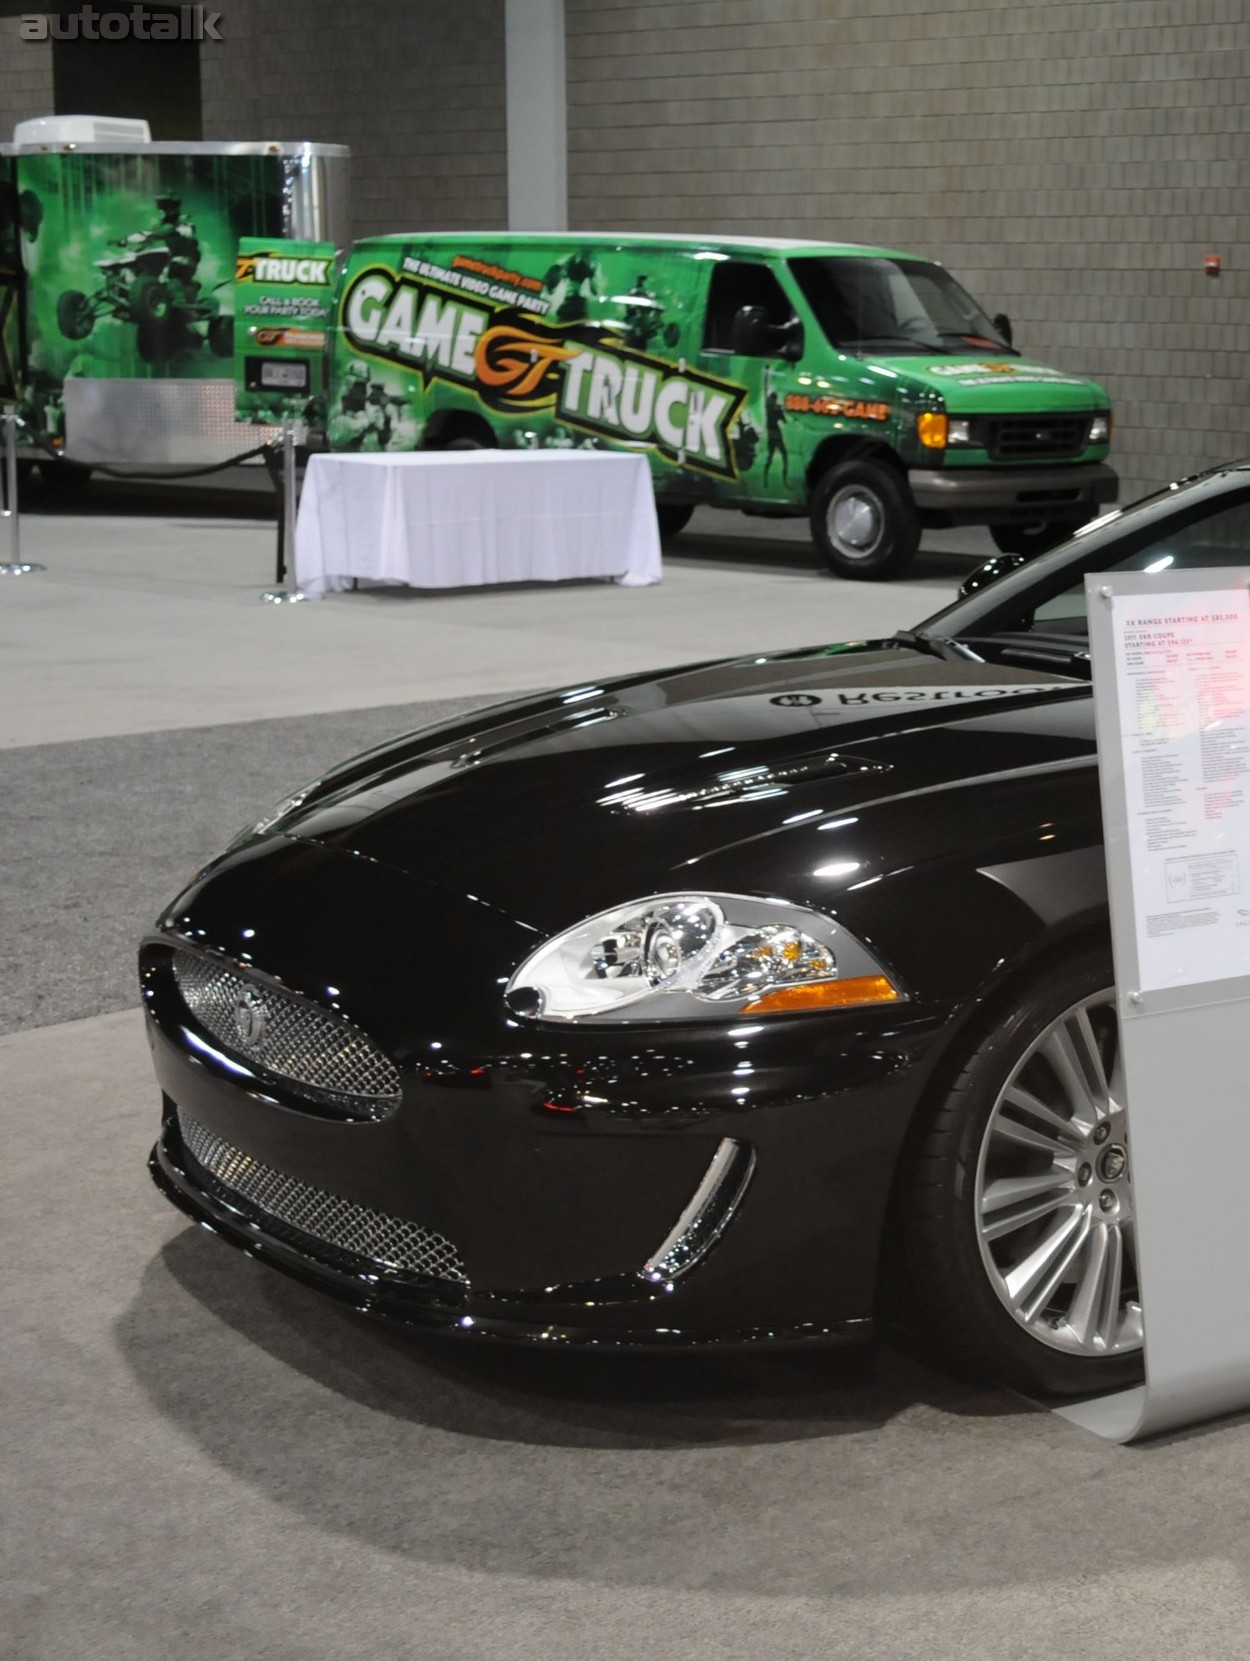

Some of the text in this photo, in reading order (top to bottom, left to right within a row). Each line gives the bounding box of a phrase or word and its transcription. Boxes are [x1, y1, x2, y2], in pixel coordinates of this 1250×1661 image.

[255, 259, 327, 284] TRUCK
[403, 257, 551, 315] THE ULTIMATE VIDEO GAME PARTY
[348, 278, 487, 375] GAME
[562, 346, 736, 462] TRUCK
[1138, 618, 1163, 626] RANGE
[1164, 615, 1198, 625] STARTING
[1201, 614, 1210, 622] AT
[1124, 640, 1156, 649] STARTING
